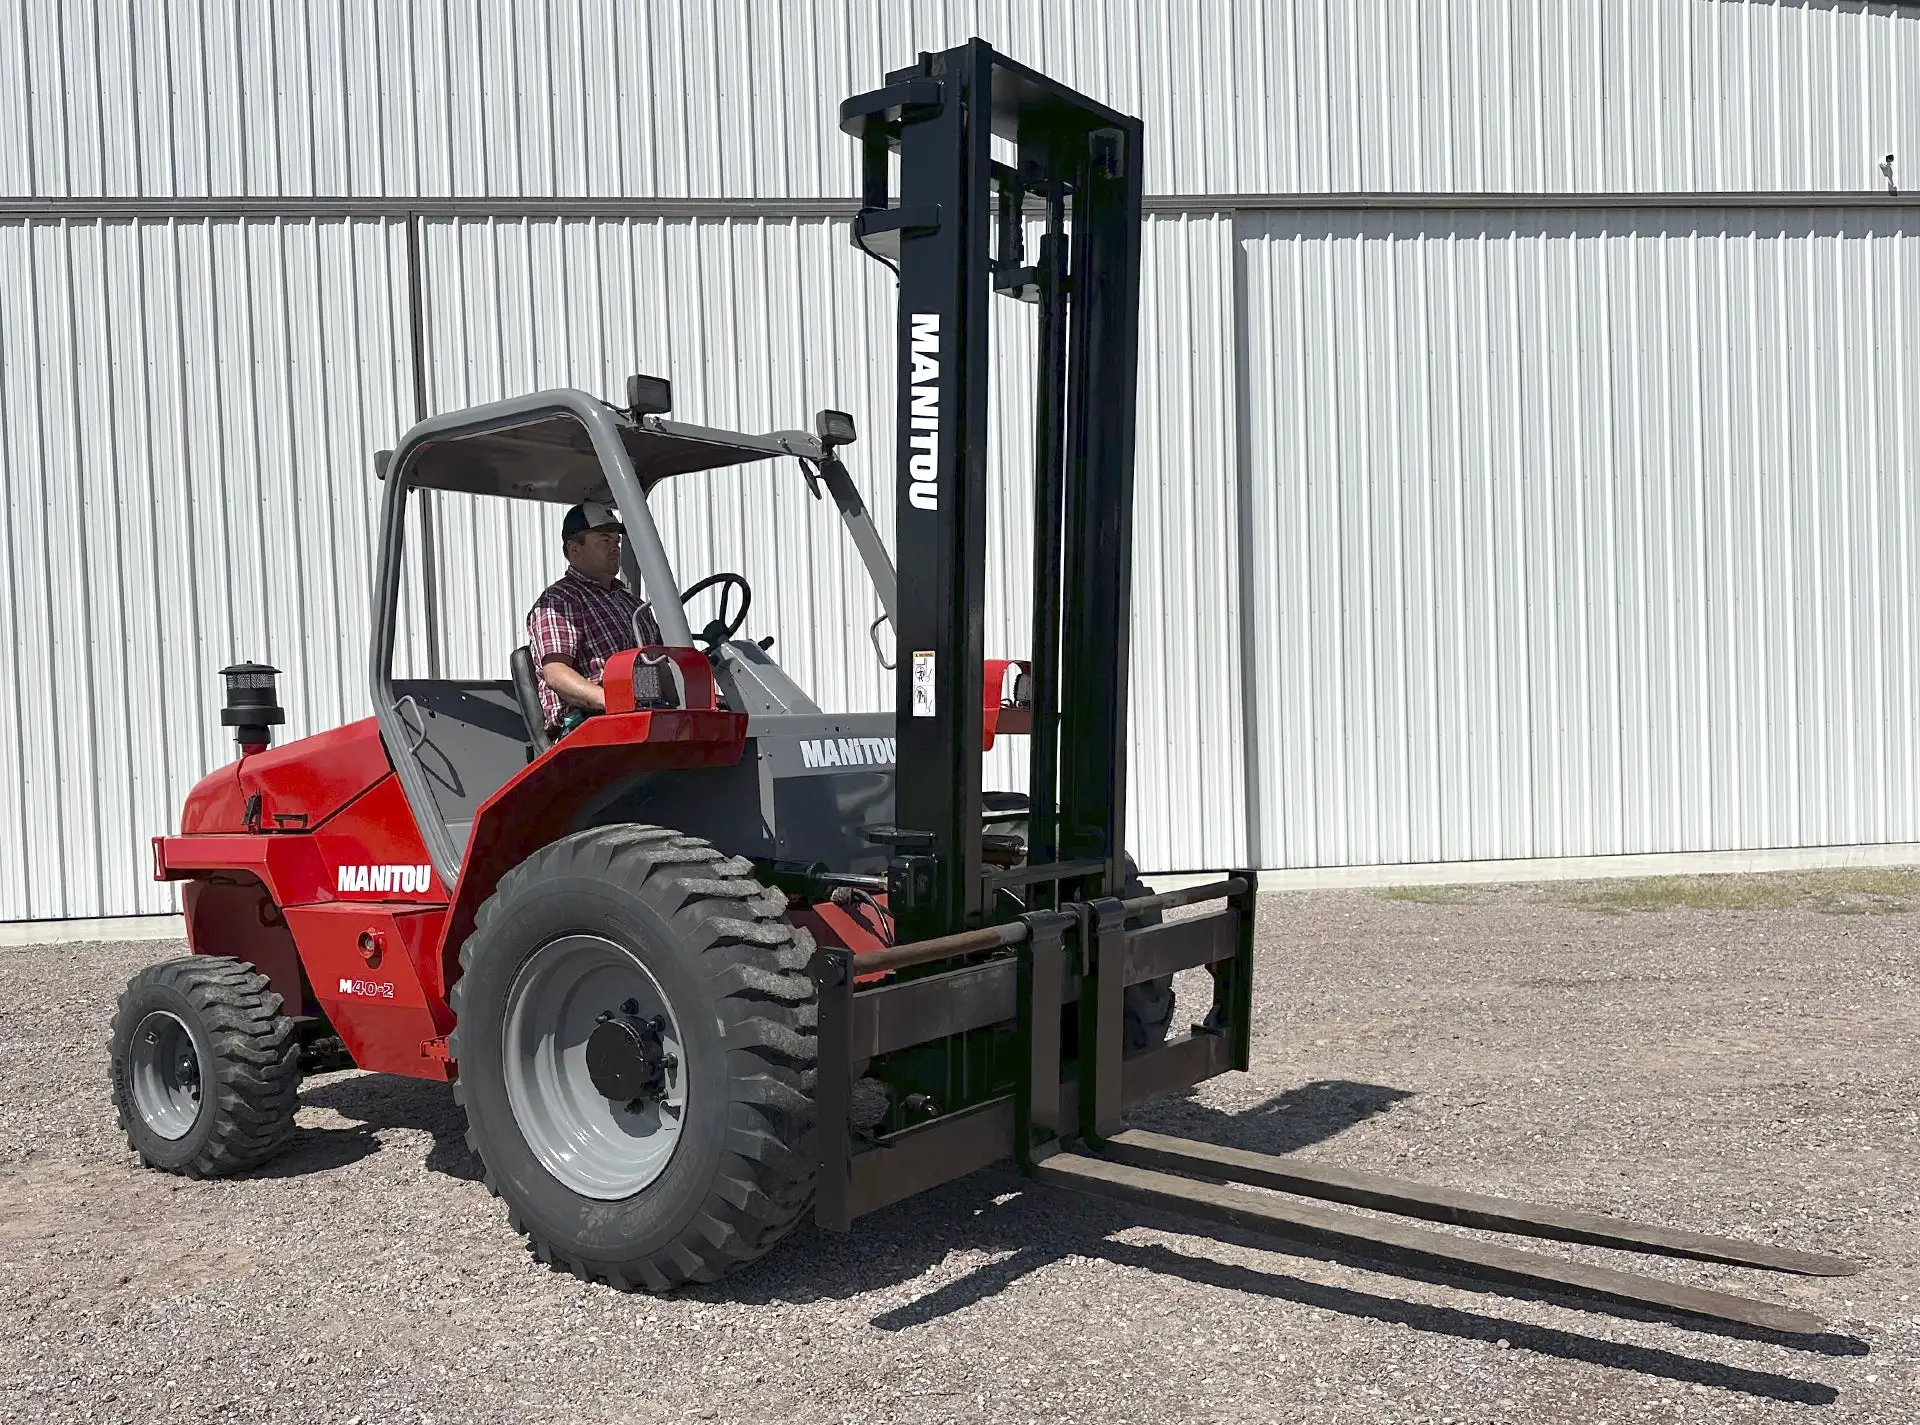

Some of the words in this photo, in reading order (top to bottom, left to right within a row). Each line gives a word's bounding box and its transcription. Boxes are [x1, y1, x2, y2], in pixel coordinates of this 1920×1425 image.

[909, 313, 939, 510] MANITOU
[337, 865, 431, 893] MANITOU
[339, 978, 395, 998] M40-2
